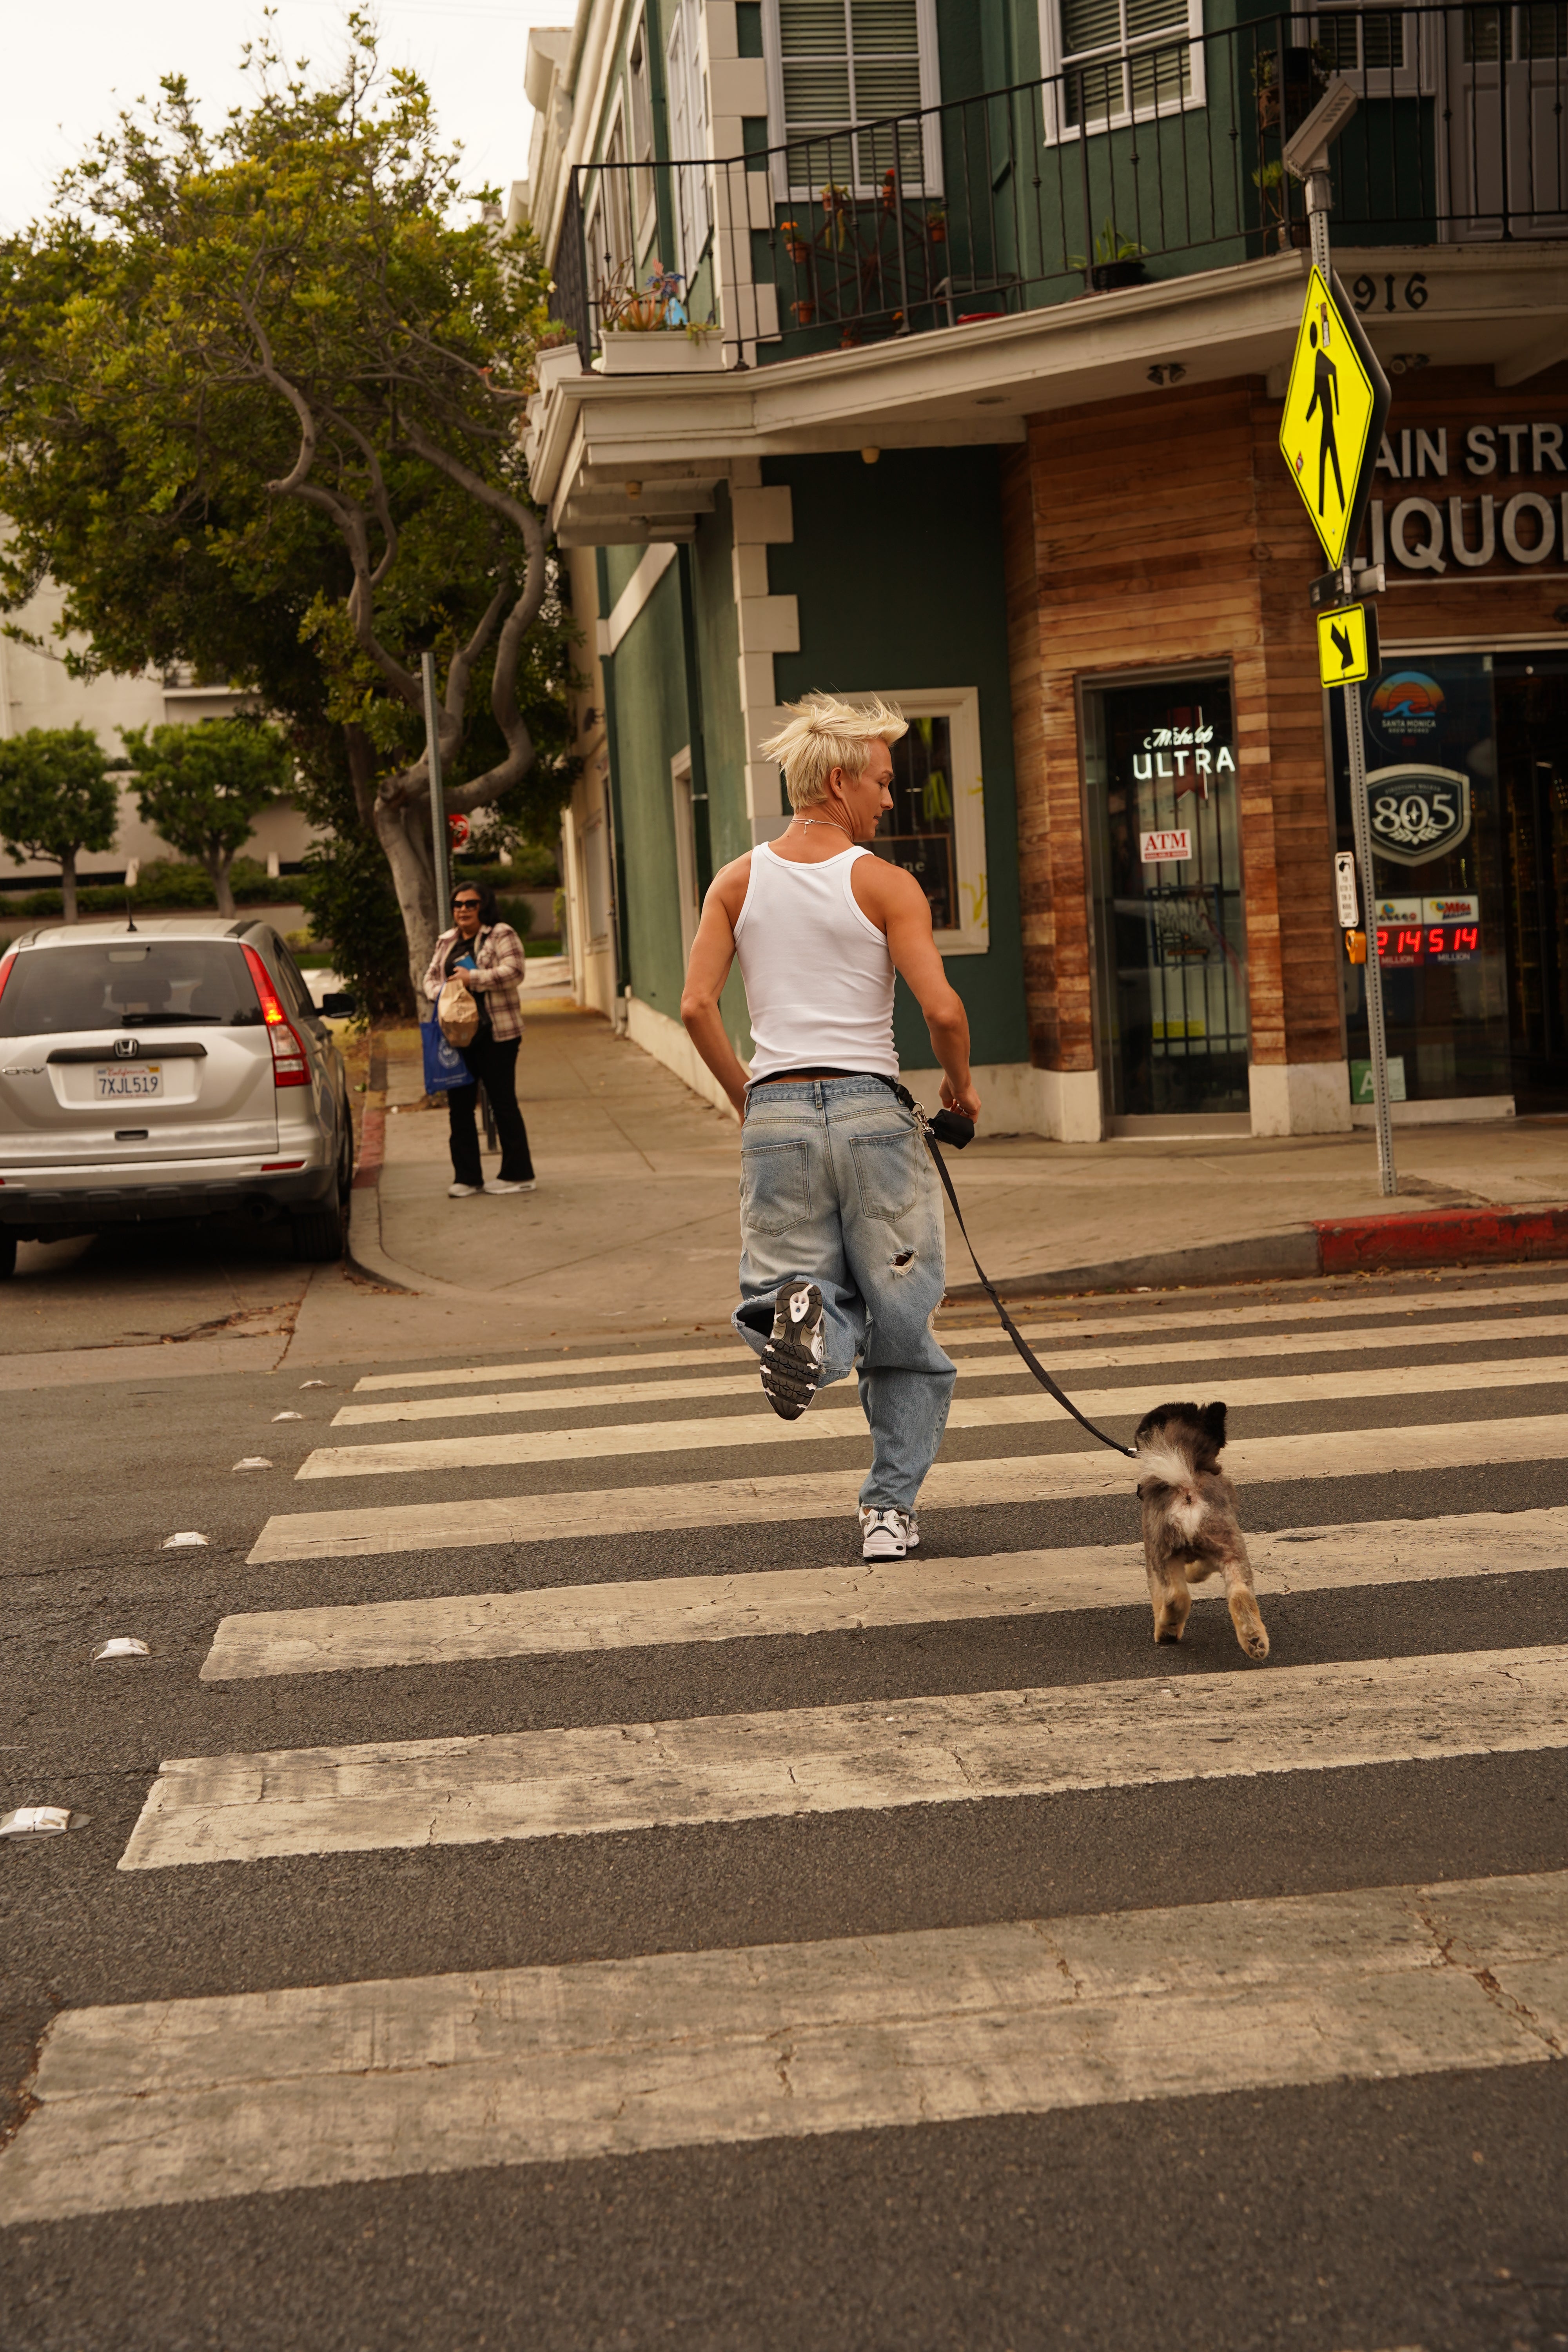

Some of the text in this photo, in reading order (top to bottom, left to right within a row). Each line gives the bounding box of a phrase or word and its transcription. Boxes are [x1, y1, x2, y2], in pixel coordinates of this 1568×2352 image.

[1353, 272, 1429, 312] 916
[1375, 423, 1567, 478] AIN STR
[1352, 492, 1568, 573] IQUO
[1382, 719, 1436, 728] SANTA MONICA
[1133, 746, 1236, 780] ULTRA
[1372, 794, 1456, 833] 805
[1145, 832, 1188, 851] ATM
[1381, 955, 1414, 964] MILLION
[1437, 953, 1470, 962] MILLION
[99, 1076, 158, 1094] 7XJL519
